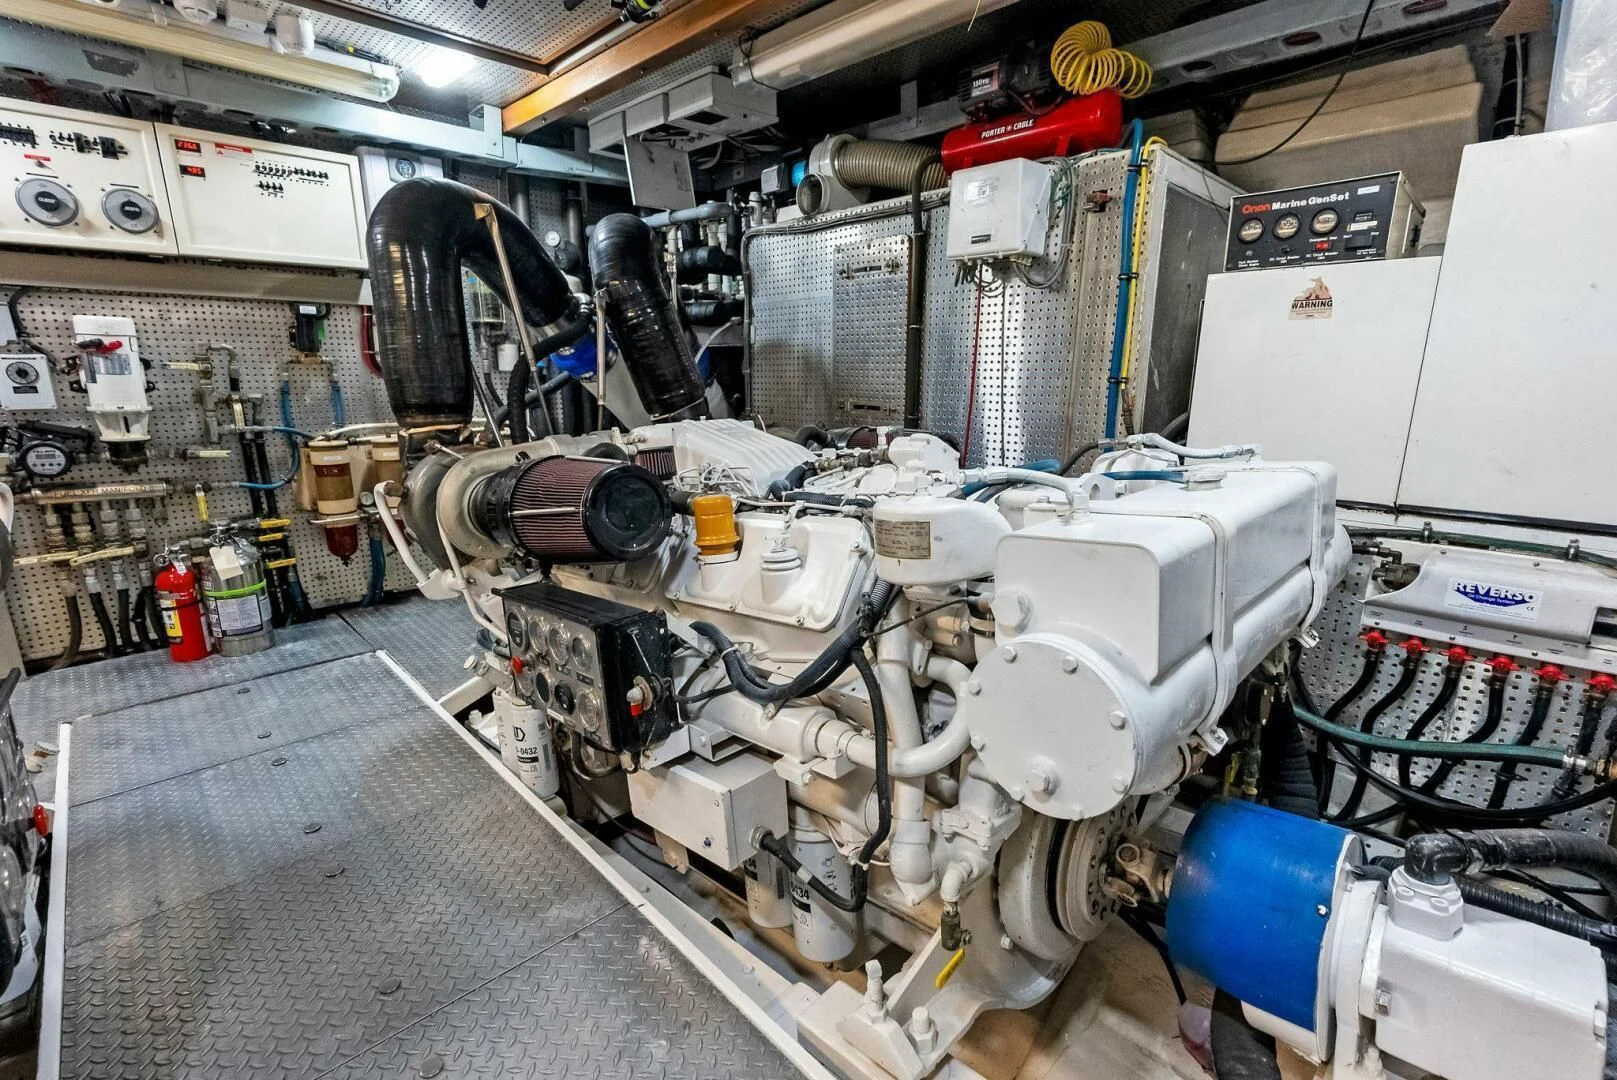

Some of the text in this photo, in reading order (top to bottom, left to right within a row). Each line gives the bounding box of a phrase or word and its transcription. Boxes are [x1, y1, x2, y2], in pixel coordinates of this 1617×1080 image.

[981, 119, 1034, 139] PORTER CABLE
[1242, 192, 1350, 214] Onan Marine GenSet
[1291, 300, 1333, 309] WARNING
[54, 489, 78, 497] FUEL
[101, 486, 147, 495] MANIFOLD
[1454, 582, 1538, 602] REVERSO
